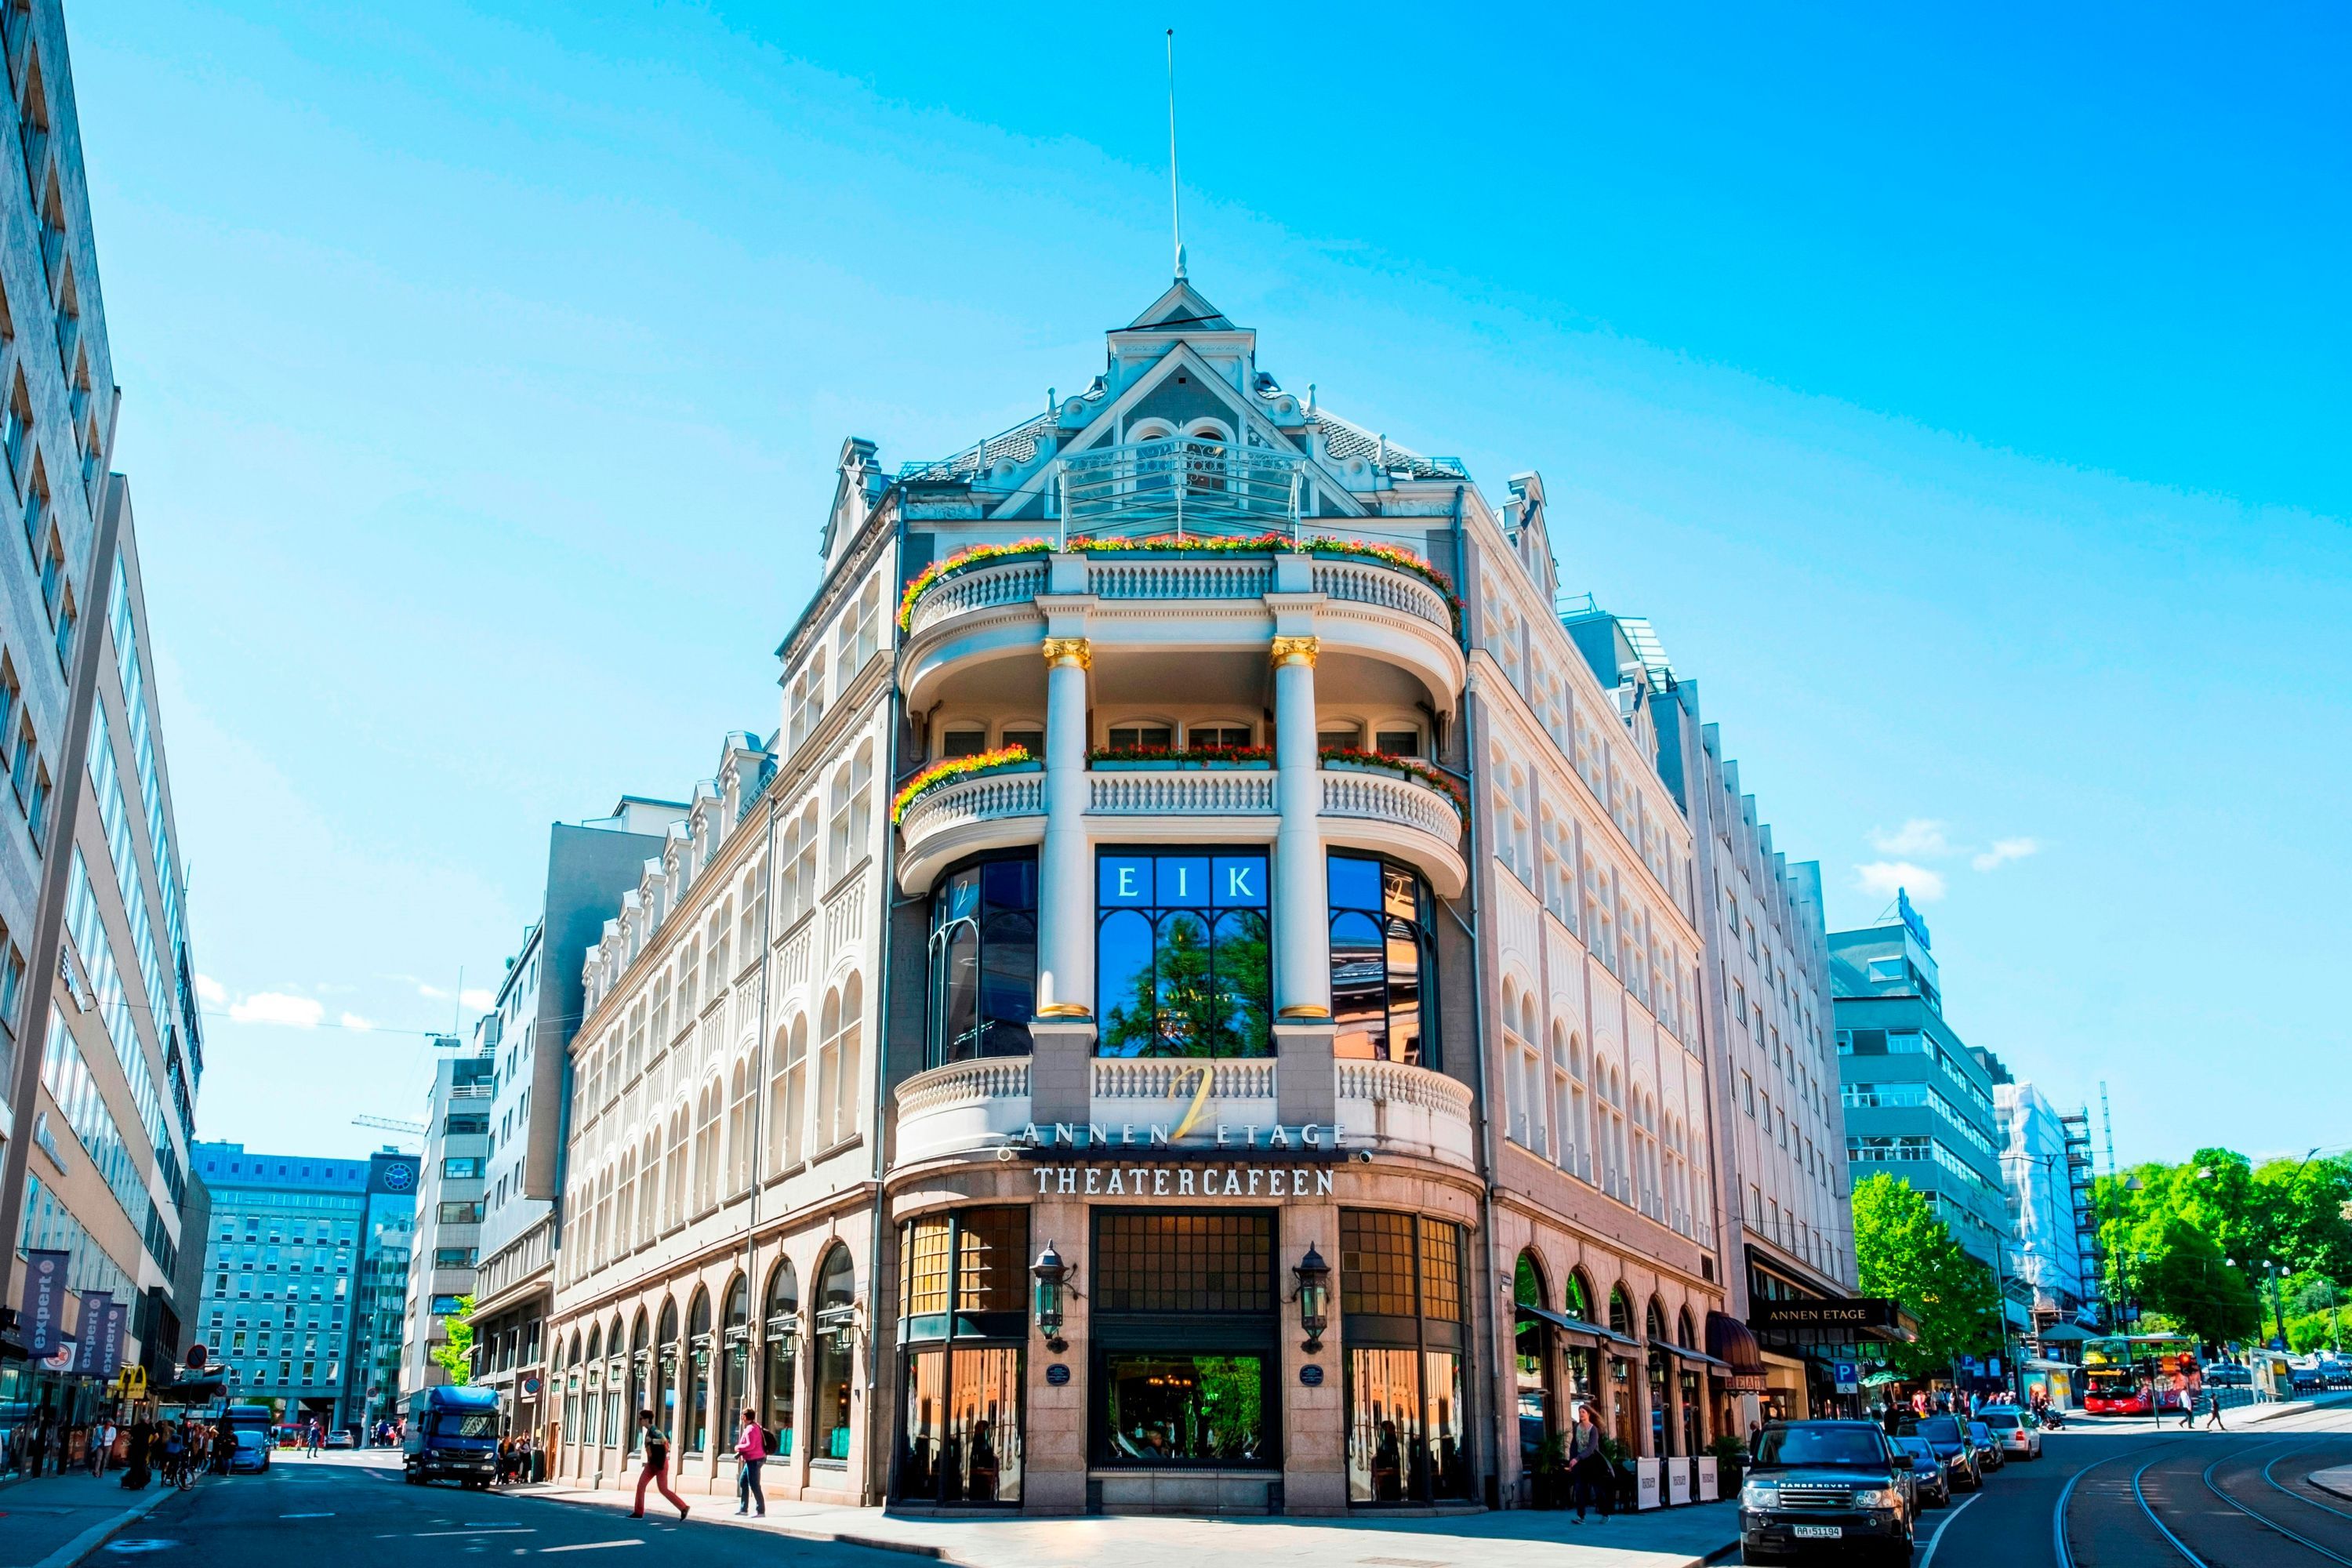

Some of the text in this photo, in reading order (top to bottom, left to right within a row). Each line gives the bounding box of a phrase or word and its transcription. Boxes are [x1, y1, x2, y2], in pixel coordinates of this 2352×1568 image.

[1118, 867, 1255, 897] EIK
[1022, 1122, 1170, 1145] ANNEN
[1216, 1123, 1348, 1145] ETAGE
[1033, 1167, 1334, 1196] THEATERCAFEEN
[34, 1276, 53, 1349] expert
[1770, 1309, 1867, 1320] ANNEN ETAGE
[82, 1311, 99, 1369] expert
[103, 1322, 117, 1374] expert
[1839, 1365, 1850, 1381] P
[1965, 1356, 1973, 1365] P
